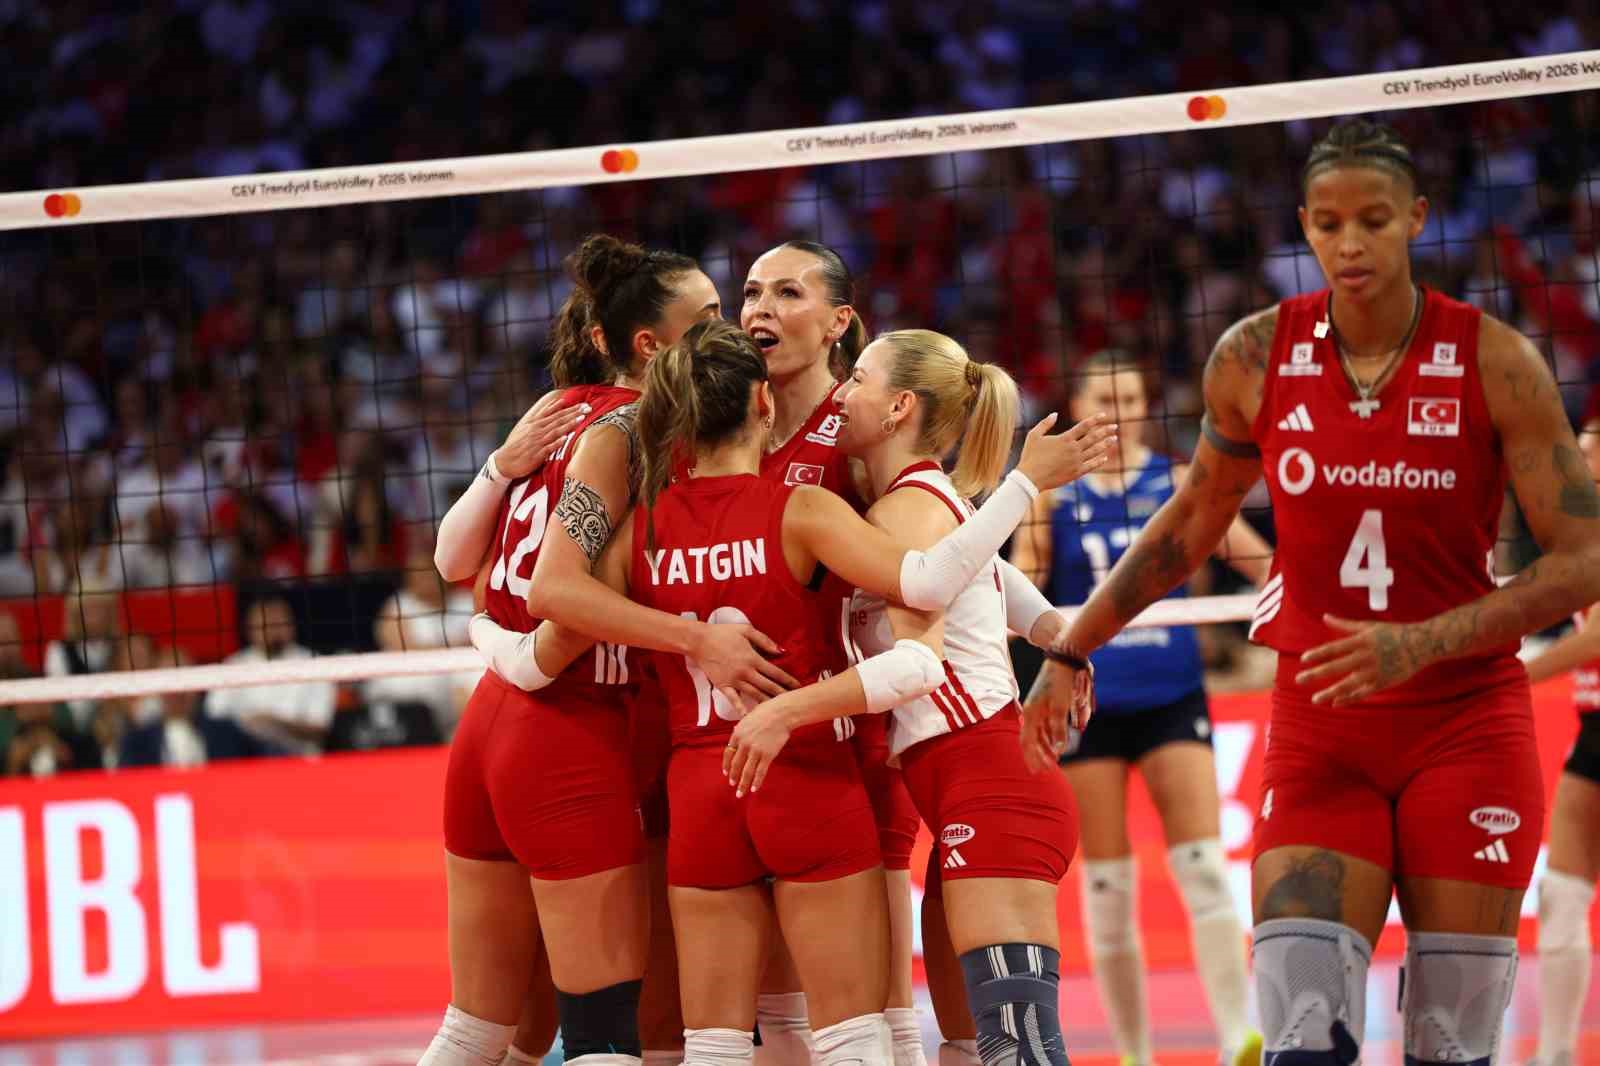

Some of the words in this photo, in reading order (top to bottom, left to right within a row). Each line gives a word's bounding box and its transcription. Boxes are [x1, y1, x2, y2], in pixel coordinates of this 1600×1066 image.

[1383, 81, 1410, 95] CEV
[1414, 75, 1469, 91] Trendyol
[1473, 67, 1541, 86] EuroVolley
[1546, 63, 1578, 78] 2026
[786, 138, 812, 152] CEV
[815, 132, 866, 148] Trendyol
[869, 127, 933, 145] EuroVolley
[937, 124, 965, 138] 2026
[970, 121, 1017, 135] Women
[231, 185, 256, 197] CEV
[260, 180, 311, 196] Trendyol
[313, 174, 374, 192] EuroVolley
[378, 173, 406, 186] 2026
[410, 171, 455, 185] Women
[1322, 460, 1457, 490] vodafone
[490, 477, 549, 601] 12
[644, 538, 767, 586] YATGIN
[1339, 508, 1395, 612] 4
[1476, 812, 1517, 826] gratis
